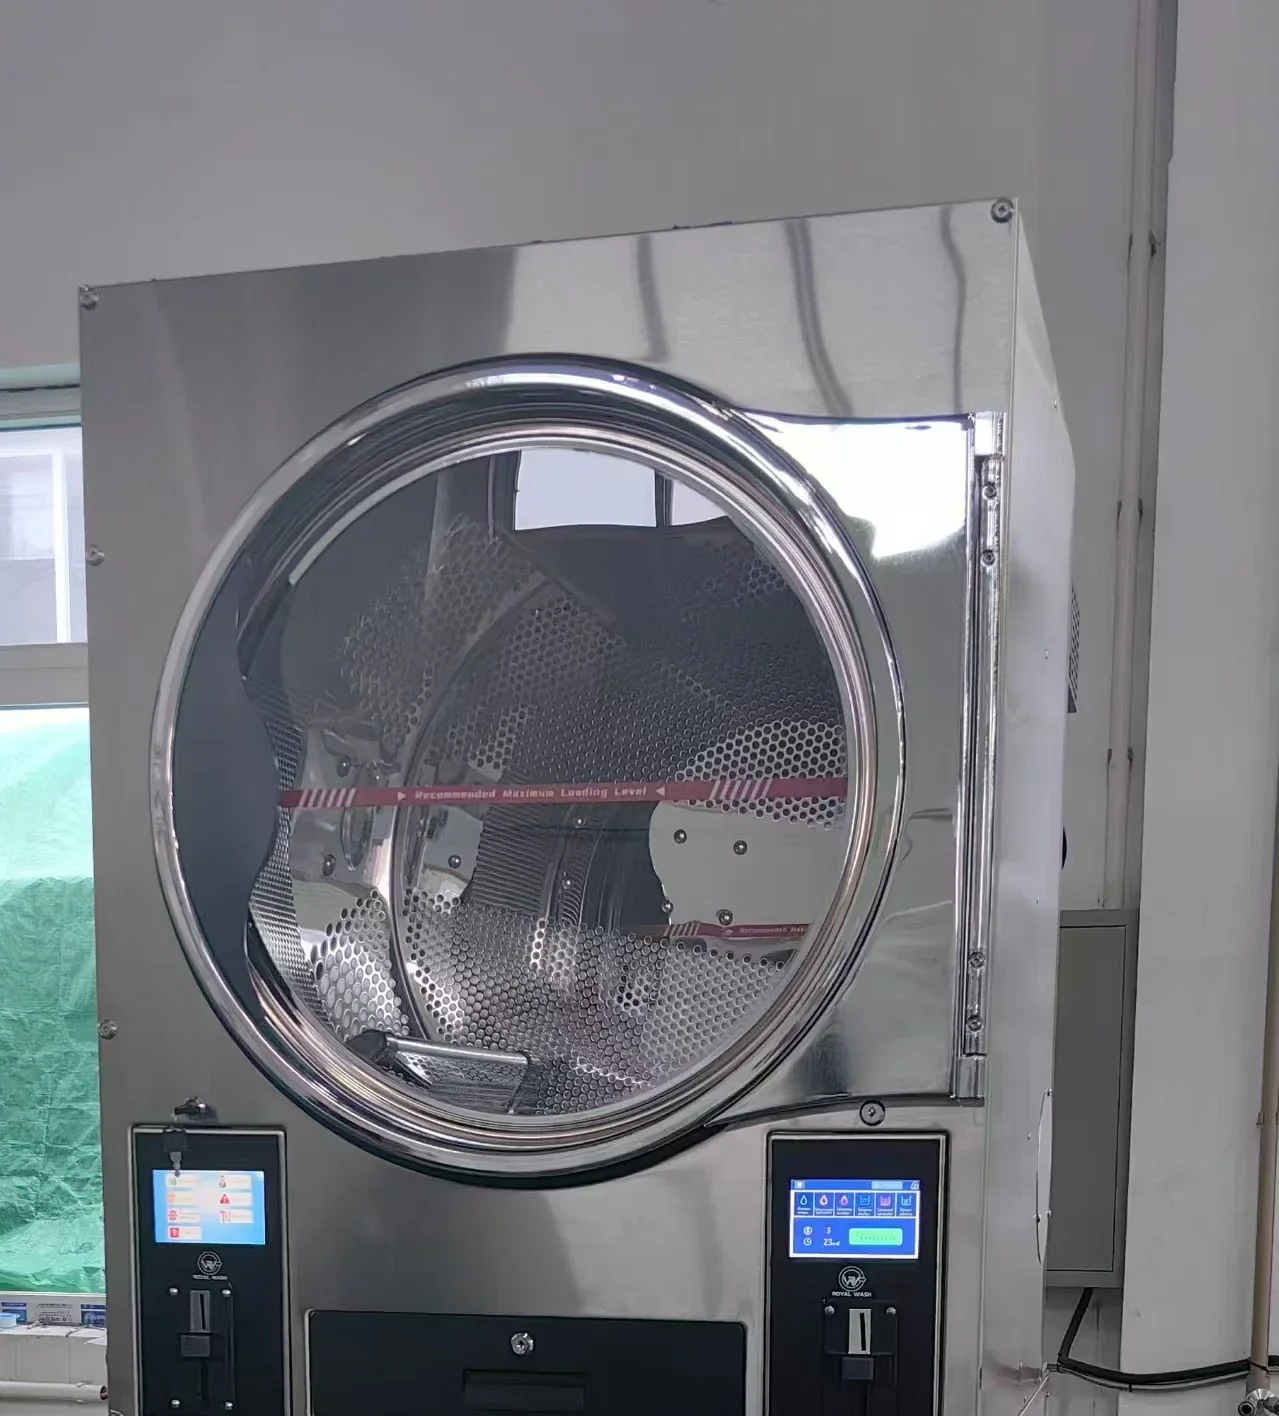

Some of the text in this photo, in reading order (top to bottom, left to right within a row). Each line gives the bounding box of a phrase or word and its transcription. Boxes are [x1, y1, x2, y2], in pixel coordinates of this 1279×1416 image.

[415, 785, 648, 801] Recommended Maximum Loading Level
